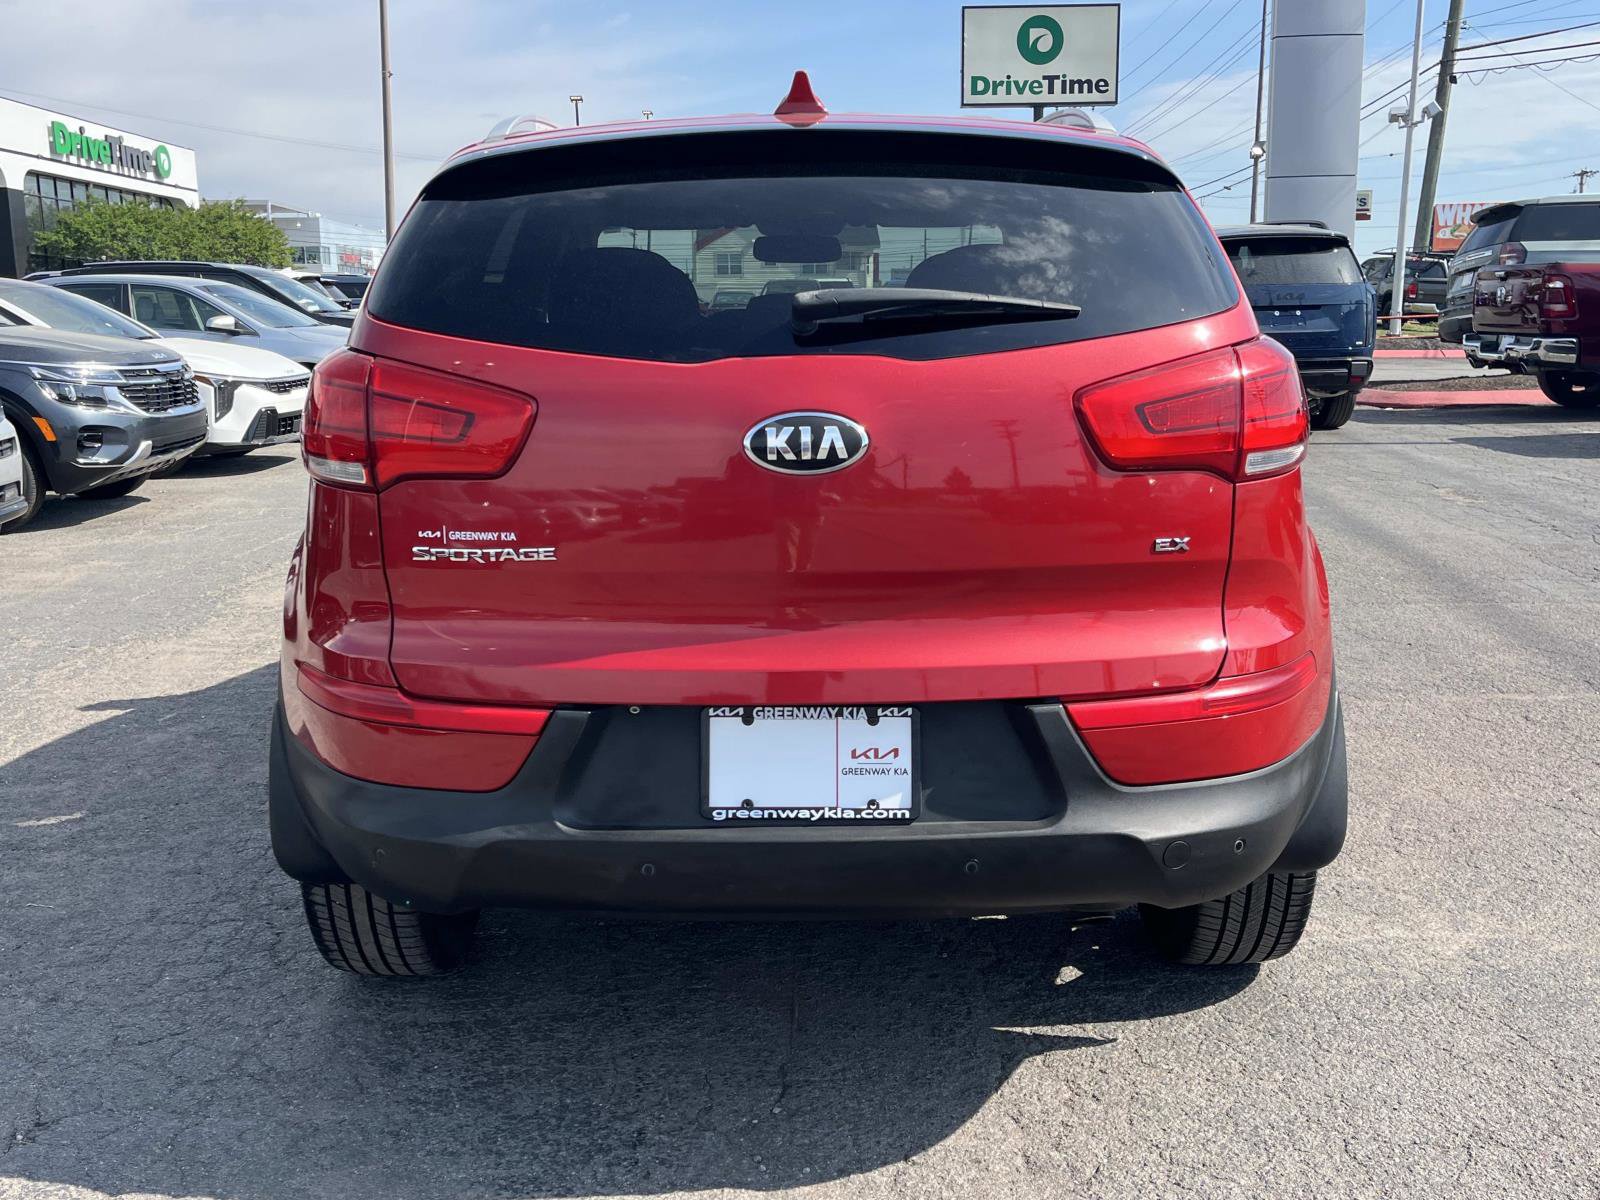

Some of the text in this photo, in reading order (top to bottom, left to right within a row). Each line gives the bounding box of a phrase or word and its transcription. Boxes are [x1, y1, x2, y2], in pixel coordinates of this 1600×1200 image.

[970, 74, 1110, 96] DriveTime
[51, 121, 153, 172] DriveTime
[765, 425, 849, 461] KIA
[448, 531, 517, 541] GREENWAY KIA
[1155, 536, 1191, 552] EX
[412, 546, 558, 564] SPORTAGE
[752, 707, 868, 720] GREENWAY KIA
[851, 747, 899, 760] KIA
[841, 767, 909, 776] GREENWAY KIA
[712, 806, 910, 821] greenwaykia.com
